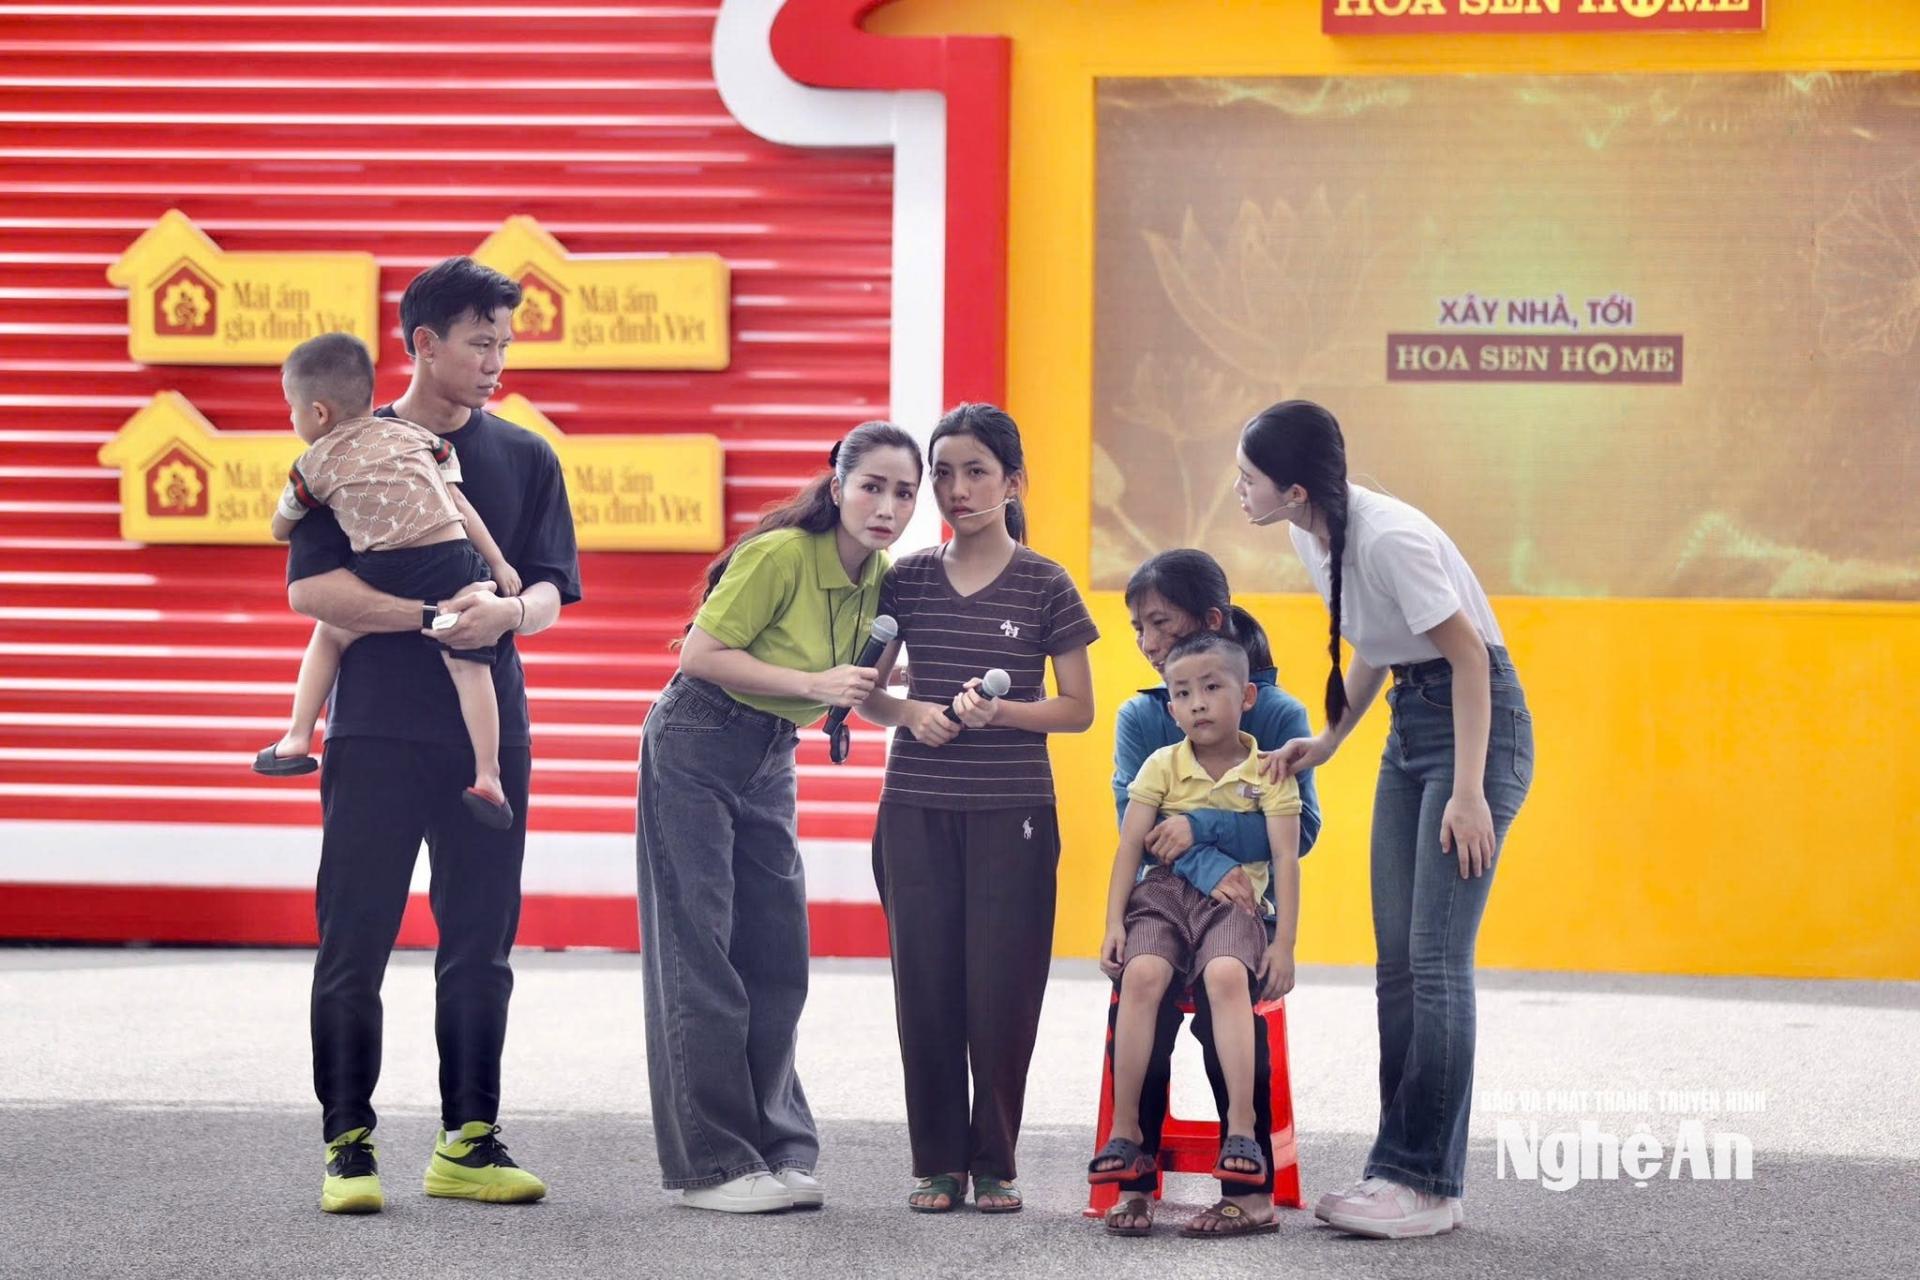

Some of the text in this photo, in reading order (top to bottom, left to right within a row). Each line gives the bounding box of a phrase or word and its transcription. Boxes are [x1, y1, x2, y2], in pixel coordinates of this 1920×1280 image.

[1440, 294, 1498, 324] XÂY
[1586, 294, 1633, 324] TỚI
[1396, 342, 1675, 374] HOA SEN HOME
